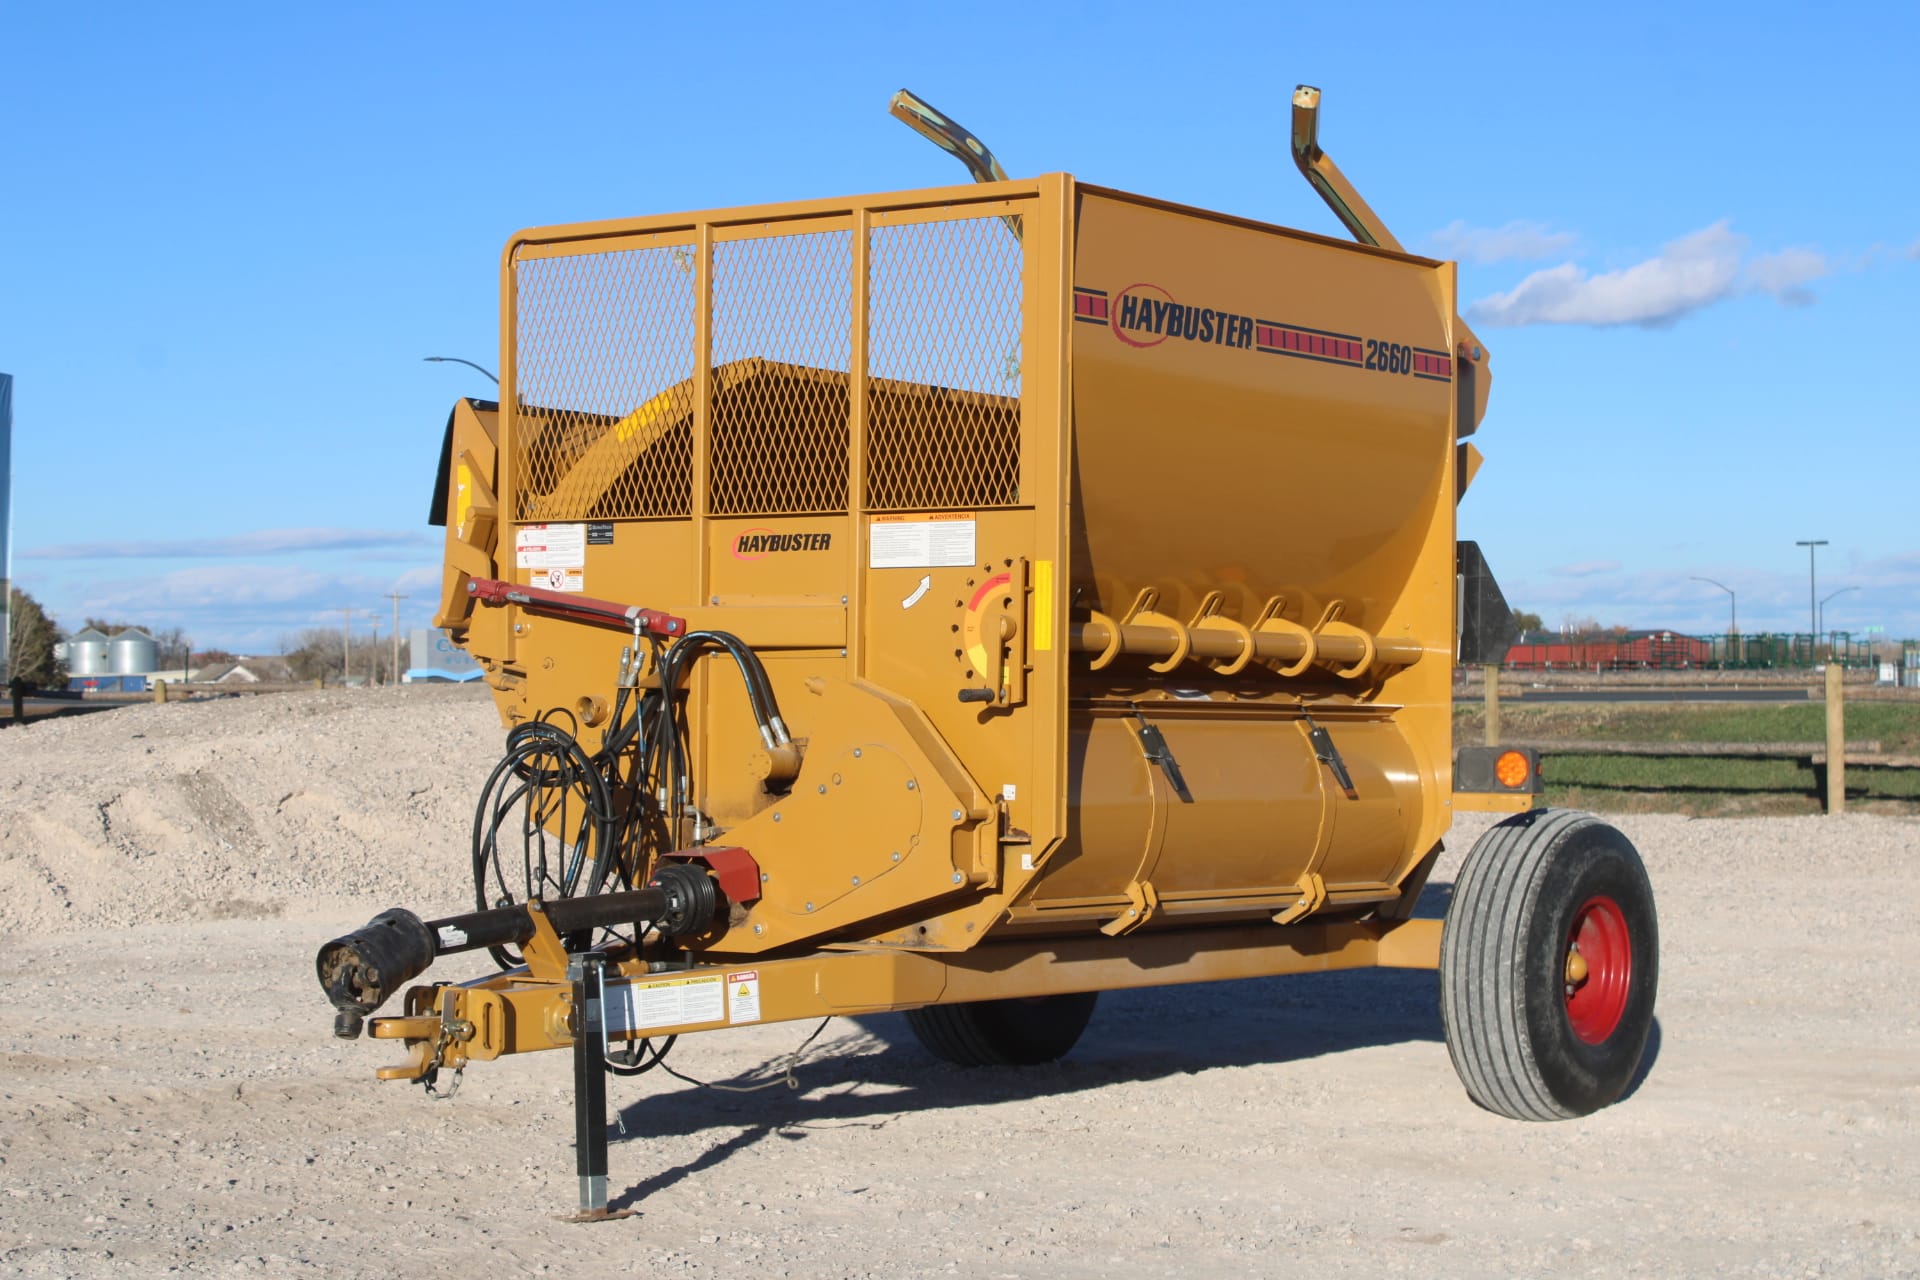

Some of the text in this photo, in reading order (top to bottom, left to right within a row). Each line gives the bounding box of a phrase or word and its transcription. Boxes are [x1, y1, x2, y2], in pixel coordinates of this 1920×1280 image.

[1120, 294, 1411, 375] HAYBUSTER 2660
[737, 533, 832, 553] HAYBUSTER
